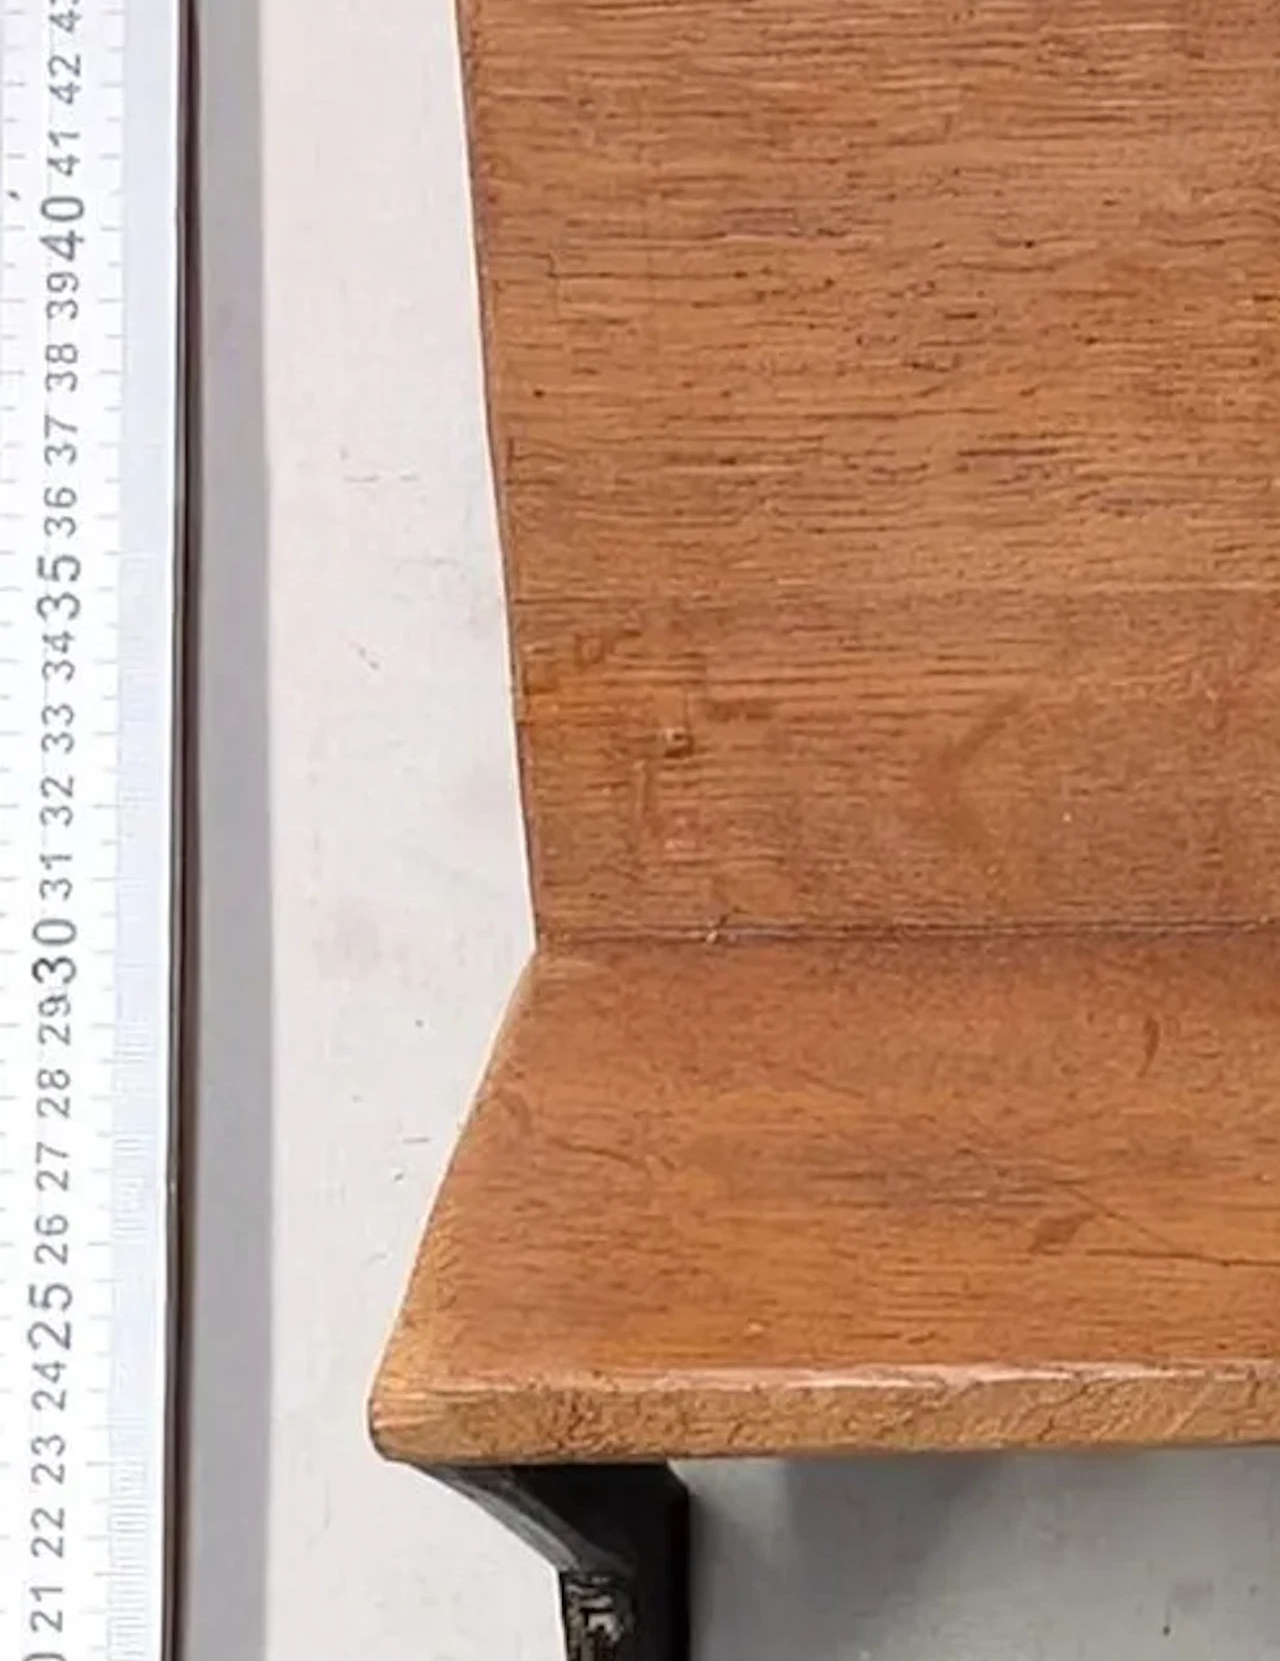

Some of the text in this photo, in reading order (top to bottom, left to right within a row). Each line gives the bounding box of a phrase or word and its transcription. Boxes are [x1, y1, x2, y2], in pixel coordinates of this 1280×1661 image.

[46, 53, 82, 107] 42
[45, 129, 82, 178] 41
[37, 195, 86, 263] 40
[43, 270, 81, 322] 39
[43, 341, 80, 394] 38
[42, 414, 79, 467] 37
[42, 485, 79, 540] 36
[34, 553, 82, 624] 35
[40, 629, 77, 684] 34
[39, 702, 77, 755] 33
[38, 774, 76, 829] 32
[37, 852, 74, 902] 31
[30, 917, 79, 987] 30
[36, 991, 72, 1047] 29
[35, 1067, 72, 1120] 28
[34, 1140, 71, 1193] 27
[32, 1213, 71, 1267] 26
[25, 1281, 74, 1352] 25
[29, 1359, 68, 1412] 24
[29, 1433, 67, 1486] 23
[29, 1506, 66, 1560] 22
[28, 1585, 64, 1634] 21
